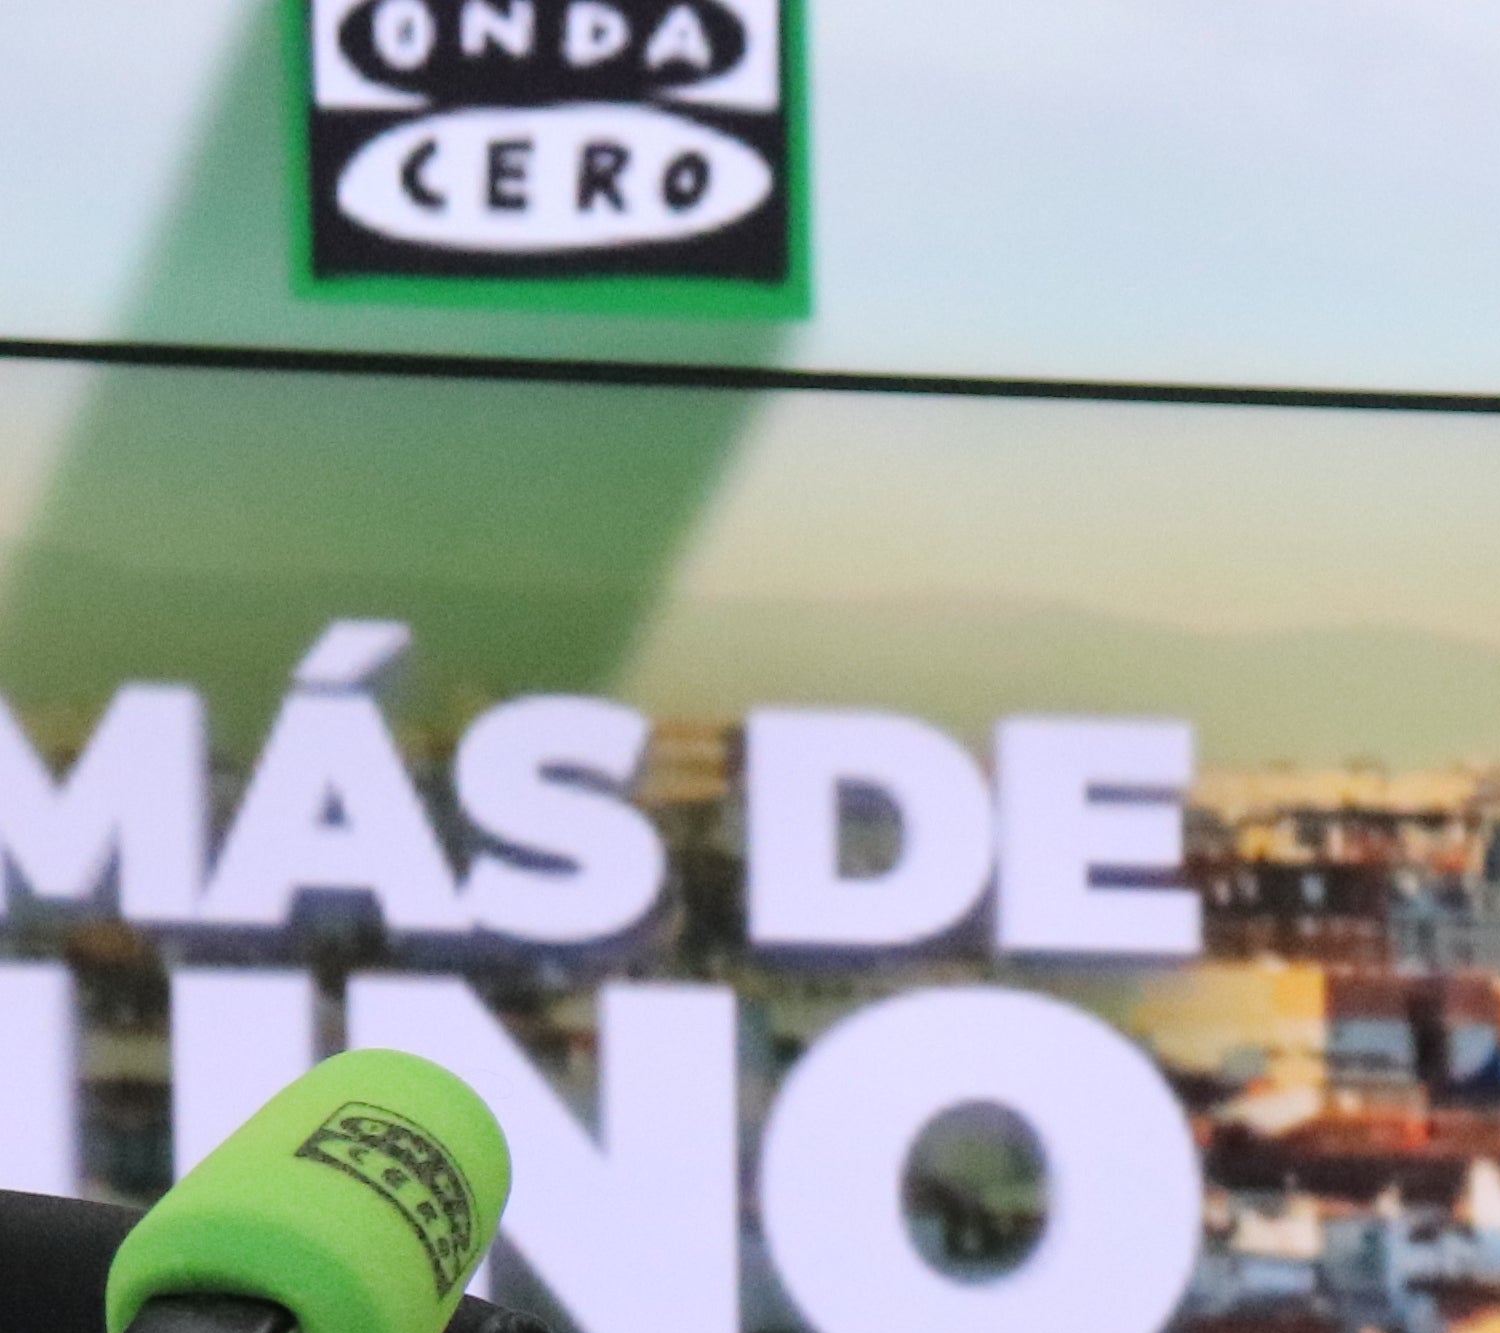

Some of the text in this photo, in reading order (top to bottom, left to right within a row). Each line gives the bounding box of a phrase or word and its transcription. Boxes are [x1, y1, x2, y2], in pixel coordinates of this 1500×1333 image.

[370, 0, 713, 68] ONDA
[399, 137, 713, 214] CERO
[0, 616, 1203, 955] MÁS DE
